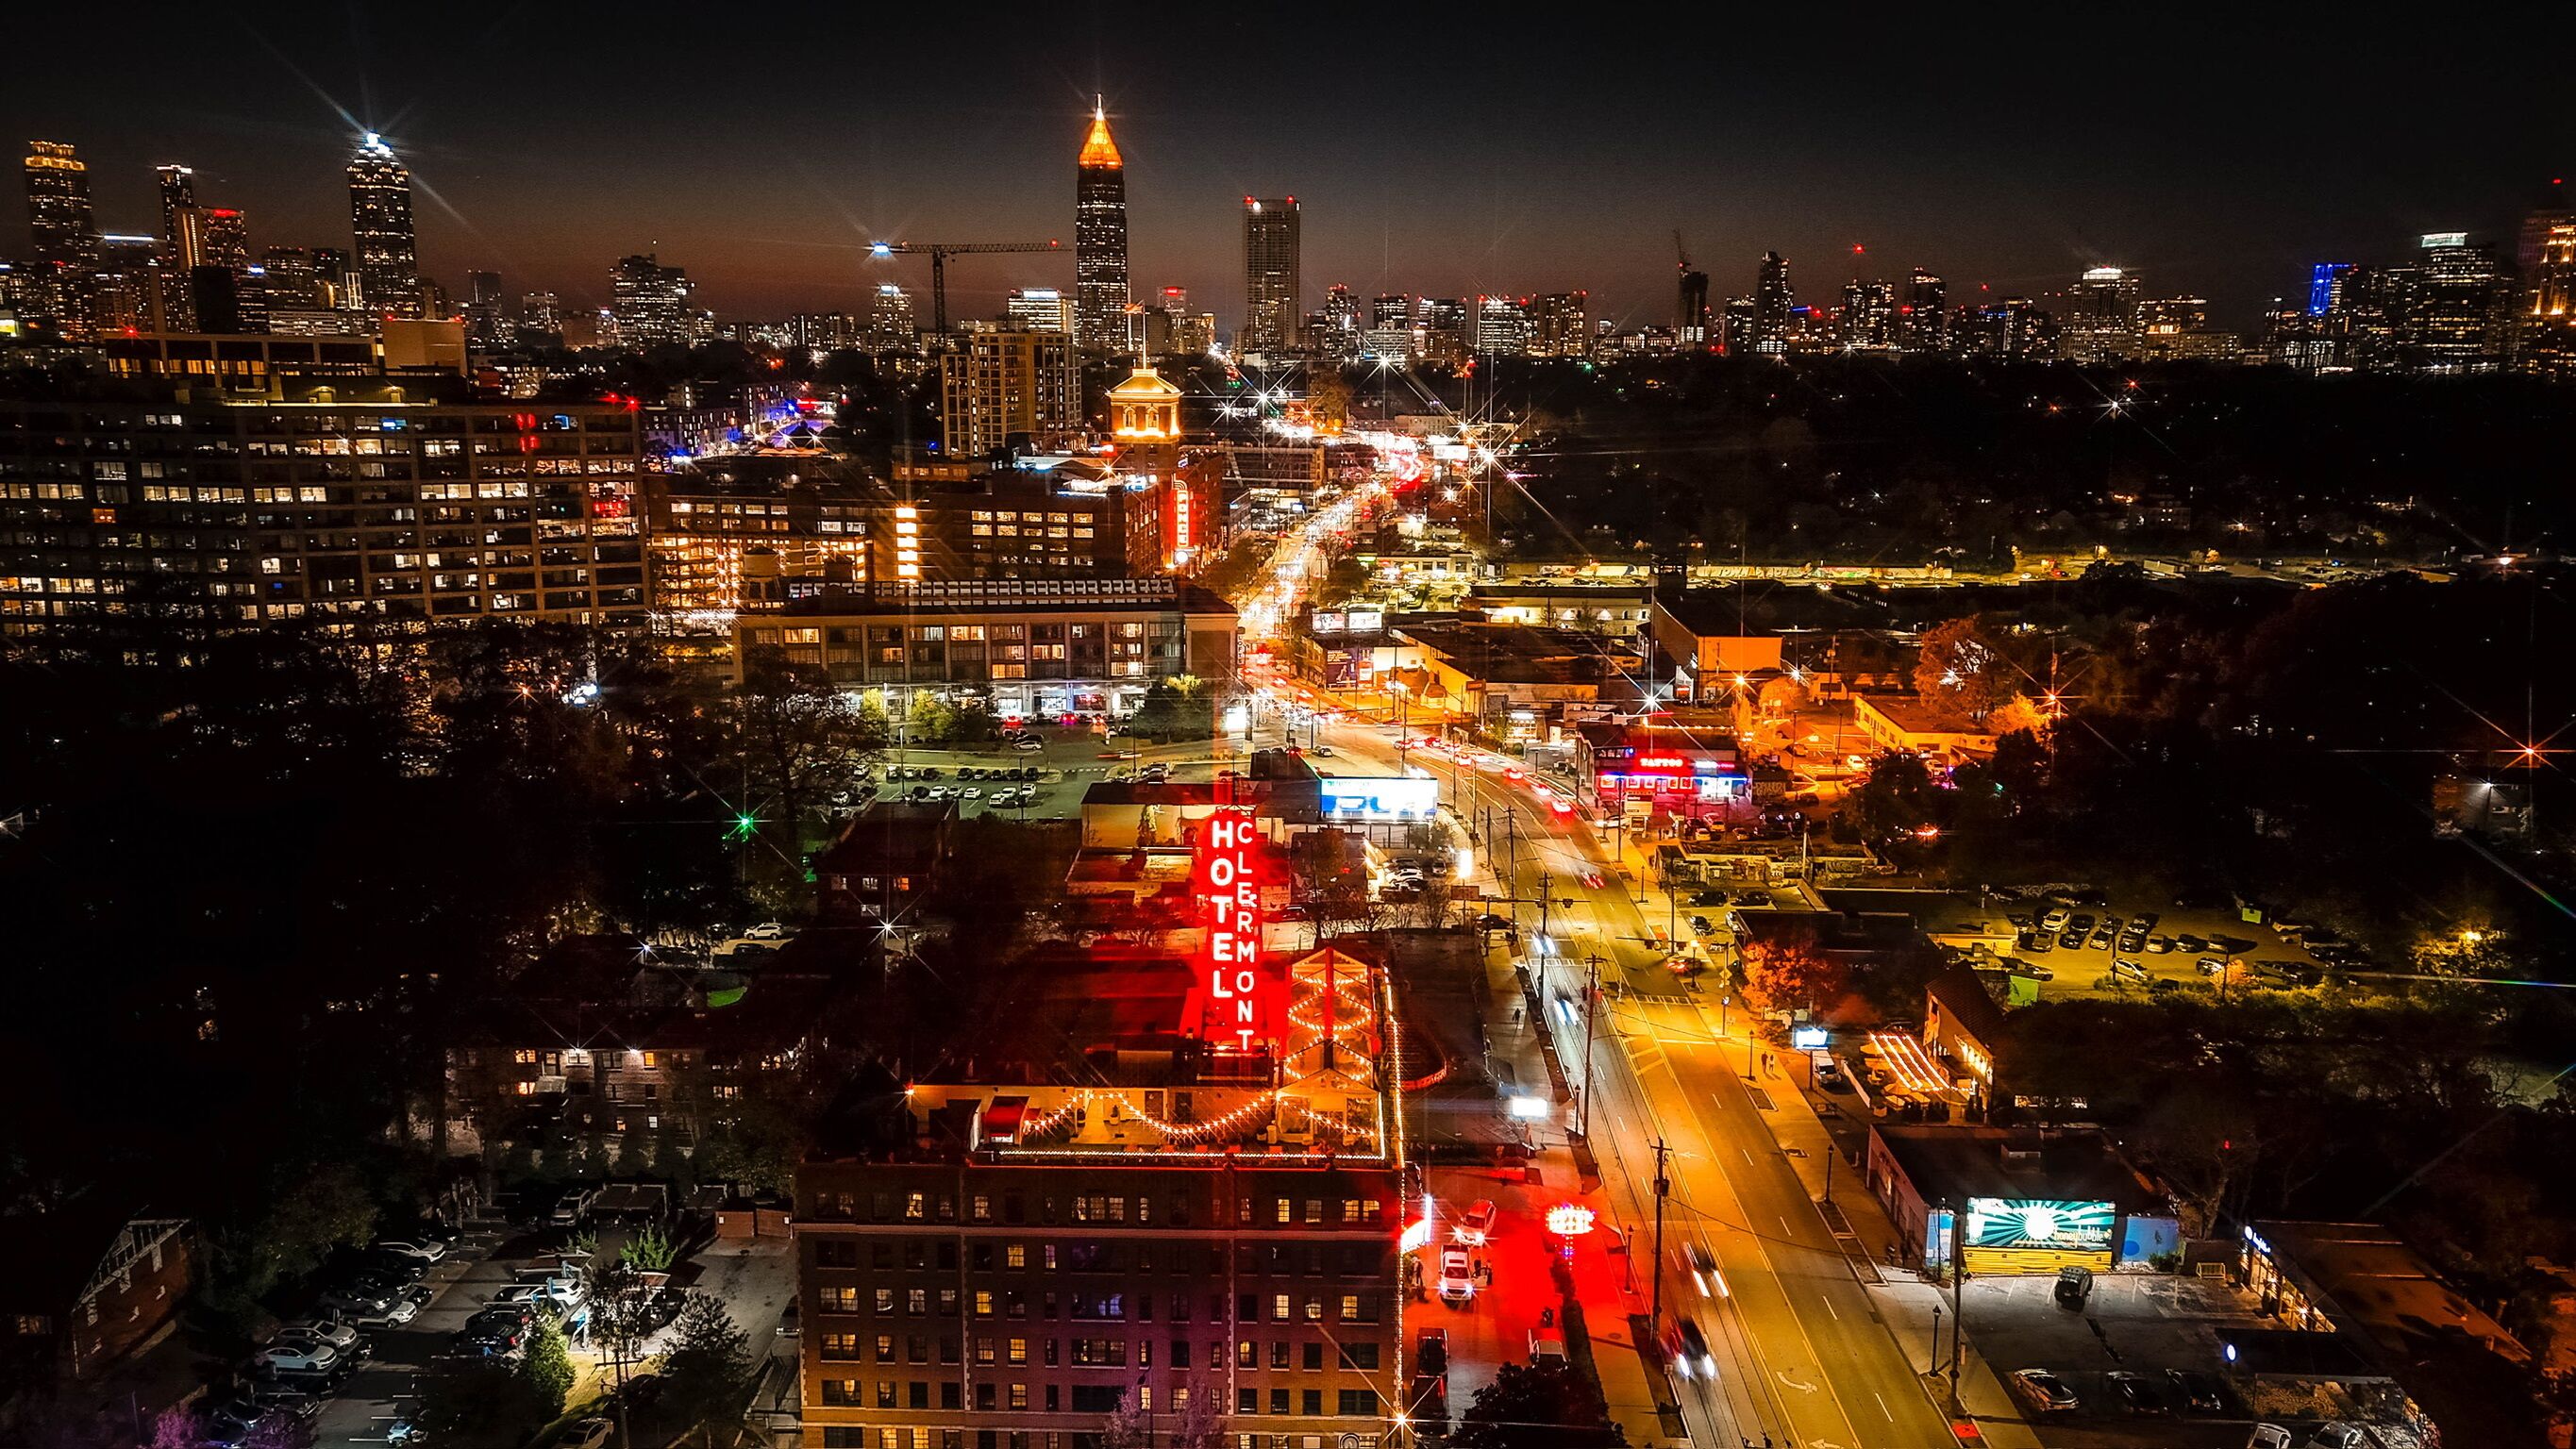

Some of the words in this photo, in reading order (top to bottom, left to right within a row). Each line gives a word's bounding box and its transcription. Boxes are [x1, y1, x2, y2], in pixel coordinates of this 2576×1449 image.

[1640, 758, 1683, 767] TATTOO
[1211, 820, 1234, 998] HOTEL
[1236, 822, 1255, 1052] CLERMONT
